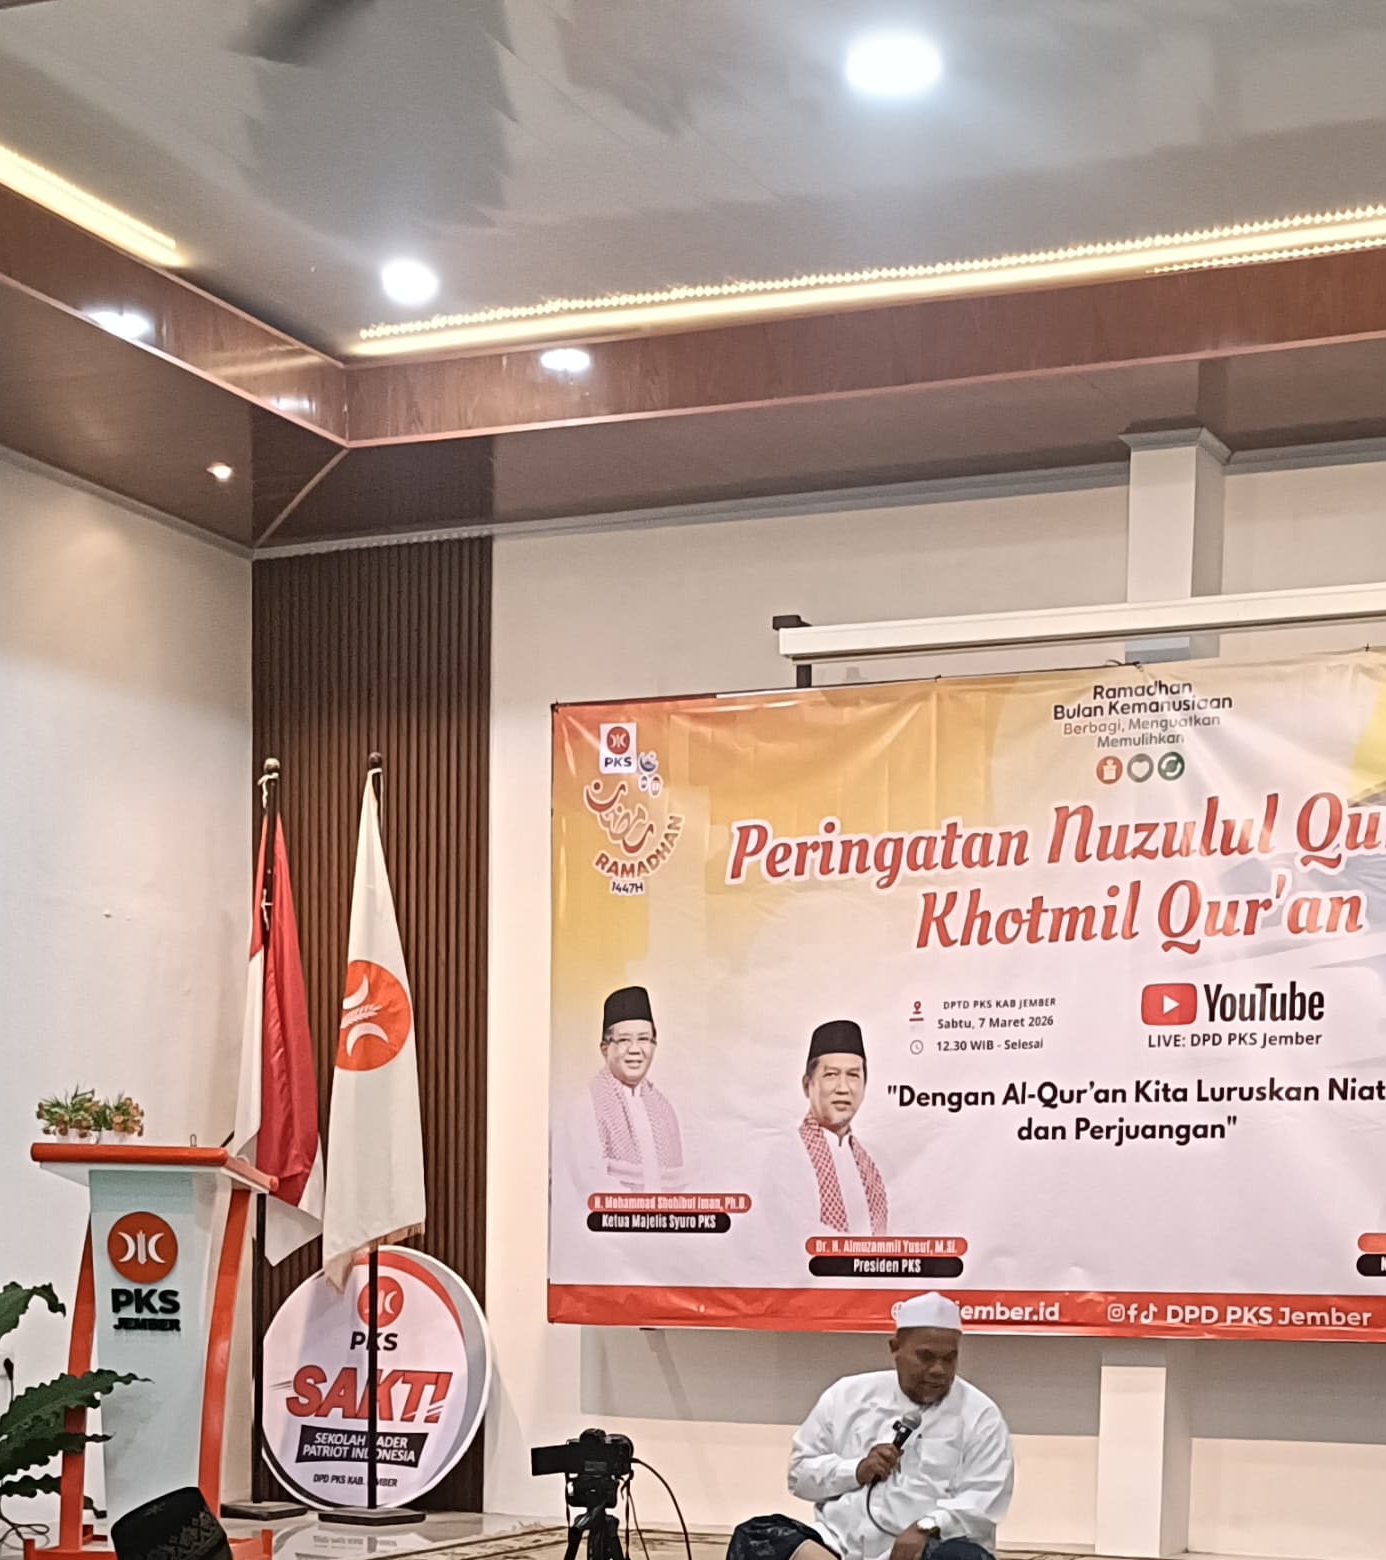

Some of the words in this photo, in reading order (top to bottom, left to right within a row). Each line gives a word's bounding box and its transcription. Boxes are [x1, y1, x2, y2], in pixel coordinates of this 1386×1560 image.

[1092, 680, 1193, 700] Ramadhan
[1053, 703, 1105, 720] Bulan
[1108, 695, 1233, 716] Kemanusiaan
[1063, 721, 1125, 735] Berbagi,
[1128, 714, 1221, 731] Menguatkan
[1096, 732, 1184, 748] Memulihkan
[604, 756, 632, 768] PKS
[595, 815, 683, 878] RAMADHAN
[730, 820, 1030, 890] Peringatan
[1047, 793, 1279, 864] Nuzulul
[611, 881, 644, 894] 1447H
[916, 880, 1142, 949] Khotmil
[1157, 874, 1365, 954] Qur'an
[943, 1000, 970, 1010] DPTD
[973, 1000, 992, 1009] PKS
[995, 999, 1016, 1008] KAB
[1018, 998, 1056, 1009] JEMBER
[1203, 981, 1325, 1022] YouTube
[937, 1018, 975, 1030] Sabtu,
[978, 1018, 986, 1028] 7
[989, 1017, 1025, 1028] Maret
[1028, 1016, 1054, 1027] 2026
[937, 1040, 967, 1051] 12.30
[970, 1040, 994, 1050] WIB
[1004, 1038, 1043, 1050] Selesai
[1148, 1033, 1185, 1049] LIVE:
[1190, 1032, 1222, 1047] DPD
[1228, 1031, 1257, 1046] PKS
[1261, 1031, 1322, 1048] Jember
[887, 1085, 996, 1113] "Dengan
[1002, 1081, 1127, 1108] Al-Qur'an
[1134, 1080, 1188, 1103] Kita
[1197, 1079, 1323, 1102] Luruskan
[1328, 1077, 1386, 1101] Niat
[1018, 1118, 1066, 1141] dan
[1074, 1115, 1237, 1146] Perjuangan"
[605, 1196, 656, 1209] Mohammad
[602, 1214, 629, 1228] Ketua
[632, 1214, 667, 1229] Majelis
[669, 1214, 696, 1230] Syuro
[698, 1215, 716, 1228] PKS
[816, 1241, 827, 1253] Dr.
[831, 1241, 841, 1253] H.
[844, 1240, 901, 1253] Almuzammil
[903, 1240, 933, 1255] Yusuf,
[854, 1259, 898, 1273] Presiden
[902, 1259, 921, 1273] PKS
[111, 1288, 180, 1314] PKS
[113, 1317, 181, 1332] JEMBER
[1166, 1306, 1219, 1324] DPD
[1225, 1306, 1273, 1325] PKS
[1276, 1307, 1372, 1328] Jember
[350, 1331, 399, 1351] PKS
[314, 1432, 366, 1446] SEKOLAH
[376, 1436, 408, 1449] ADER
[302, 1444, 349, 1459] PATRIOT
[313, 1474, 329, 1483] DPD
[330, 1475, 346, 1484] PKS
[376, 1478, 397, 1487] MBER
